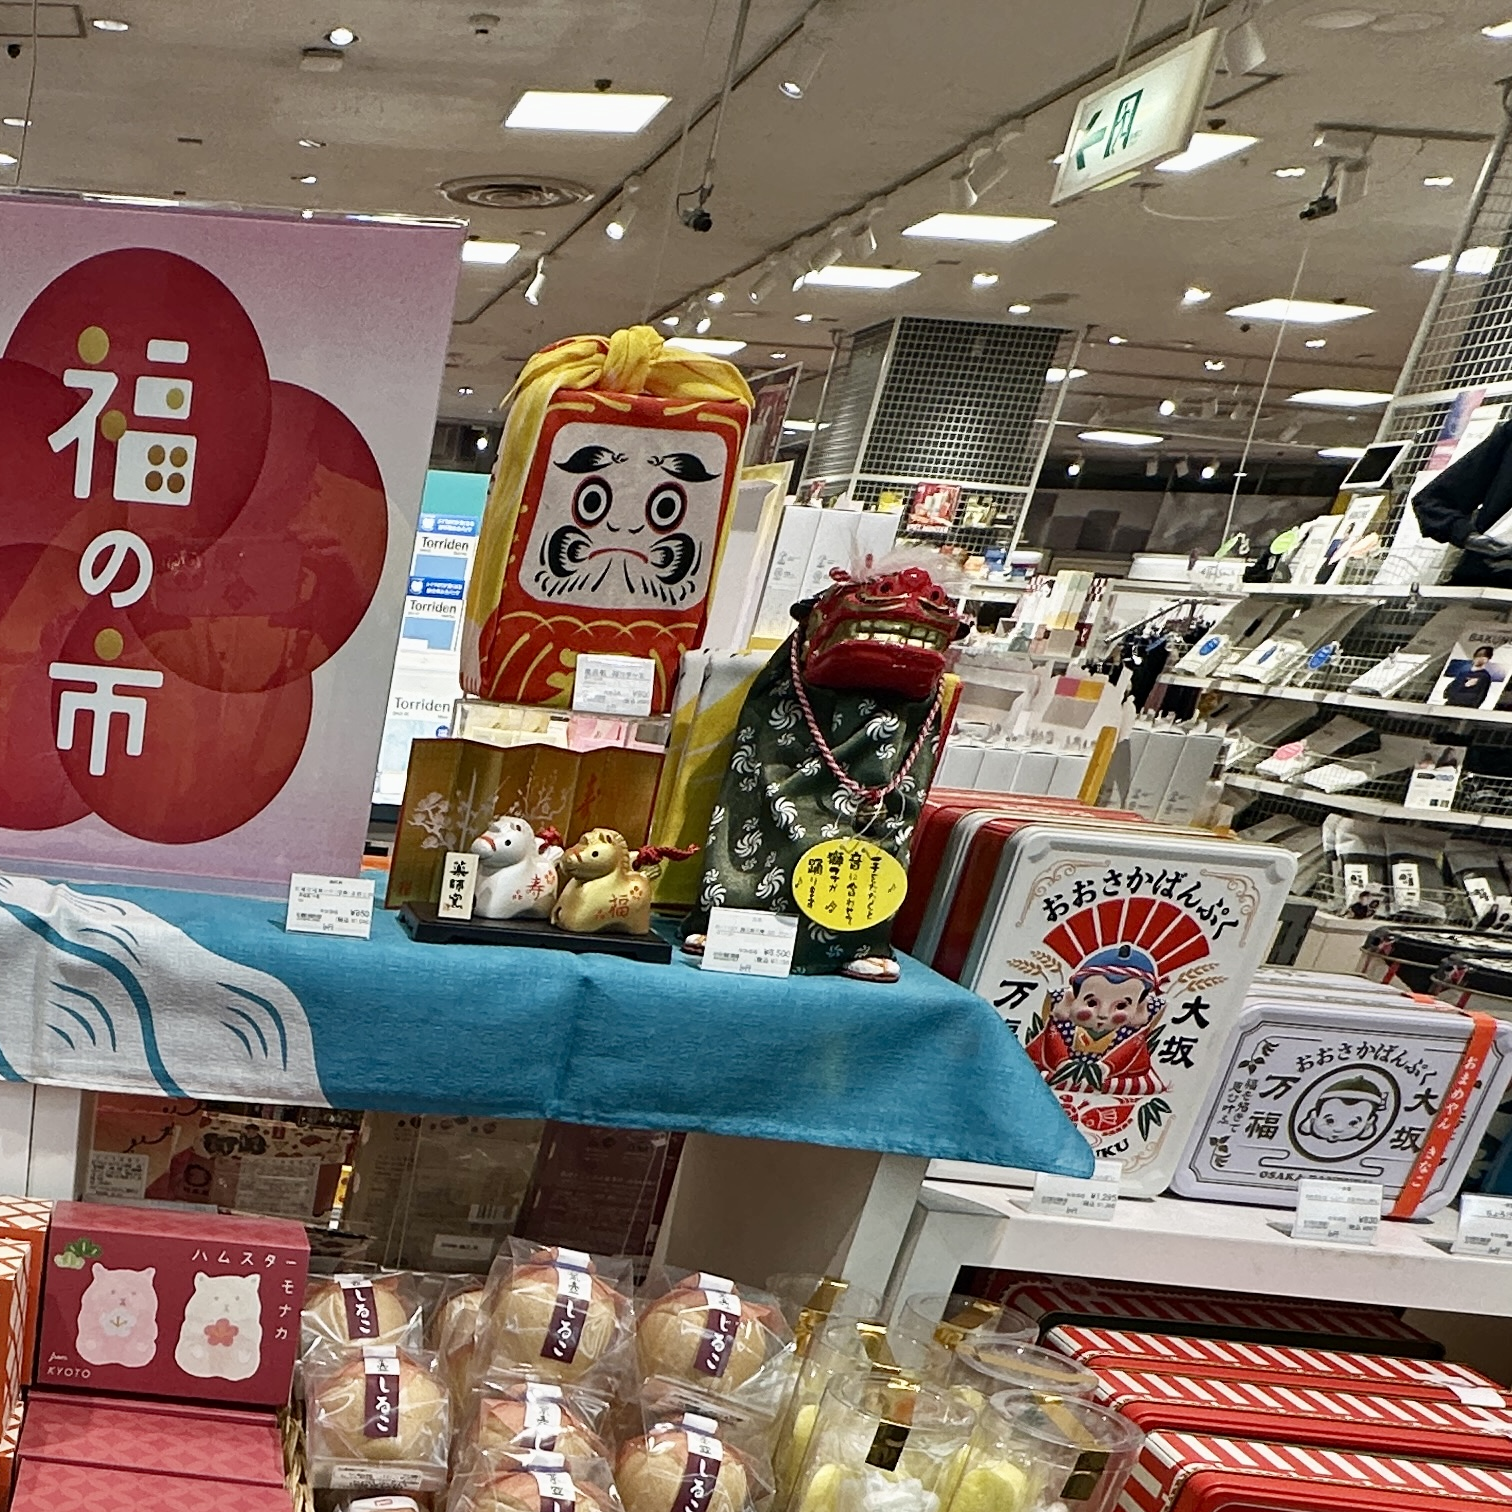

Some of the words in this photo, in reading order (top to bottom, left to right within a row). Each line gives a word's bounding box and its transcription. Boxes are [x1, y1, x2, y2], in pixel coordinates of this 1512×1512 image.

[421, 536, 470, 551] Torriden
[410, 600, 457, 614] Torriden
[395, 697, 450, 712] Torriden
[526, 874, 545, 901] 寿
[608, 894, 629, 919] 福
[1042, 866, 1239, 940] おおさかばんぷく
[1158, 995, 1211, 1068] 大坂
[1295, 1040, 1437, 1085] おおさかばんぷく
[1245, 1075, 1300, 1140] 万福
[1390, 1087, 1439, 1153] 大坂
[1411, 1146, 1436, 1188] きなこ
[191, 1248, 297, 1268] ハムスター
[275, 1278, 295, 1340] モナカ
[354, 1288, 372, 1335] しるこ
[553, 1298, 577, 1358] しるこ
[705, 1313, 729, 1370] しるこ
[46, 1366, 92, 1379] KYOTO
[375, 1376, 391, 1433] しるこ
